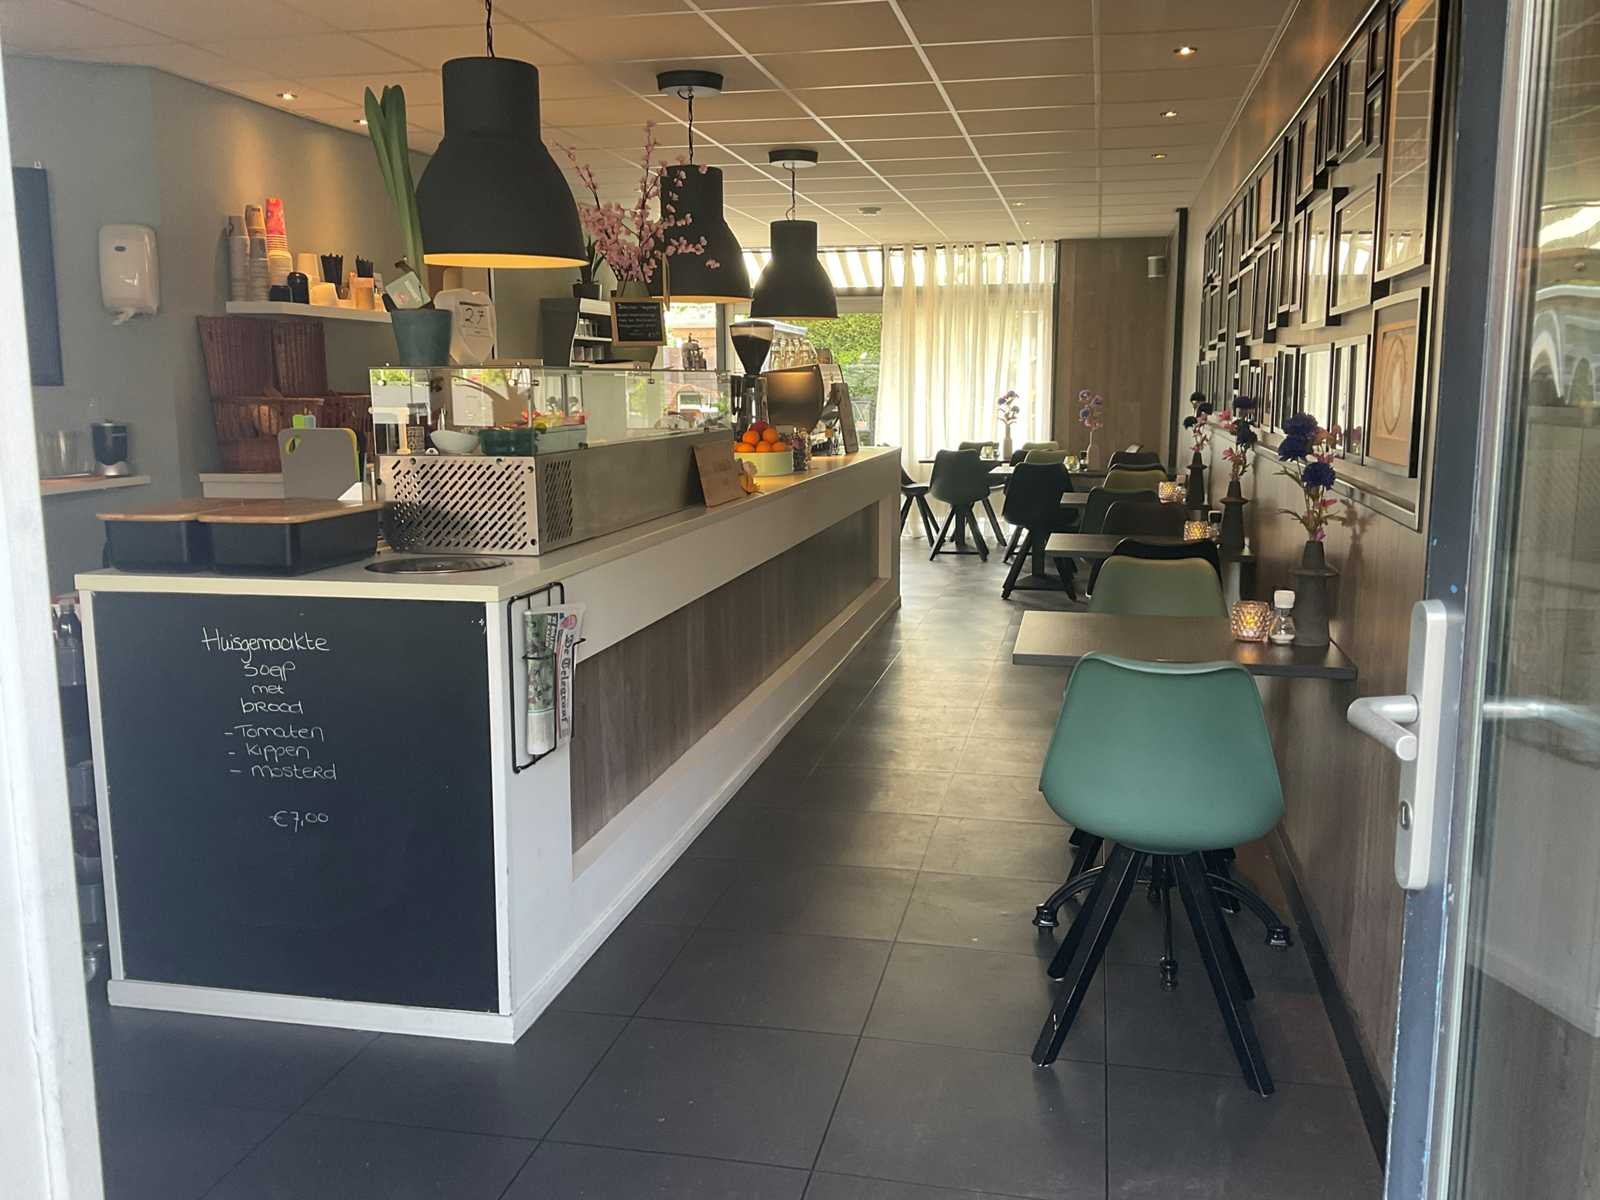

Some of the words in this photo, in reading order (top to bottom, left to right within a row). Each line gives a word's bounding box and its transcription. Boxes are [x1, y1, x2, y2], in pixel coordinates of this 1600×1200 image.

[201, 626, 331, 664] Huisgemaakte
[251, 684, 285, 695] met
[234, 723, 325, 742] Tomaten
[269, 810, 329, 833] €7,00
